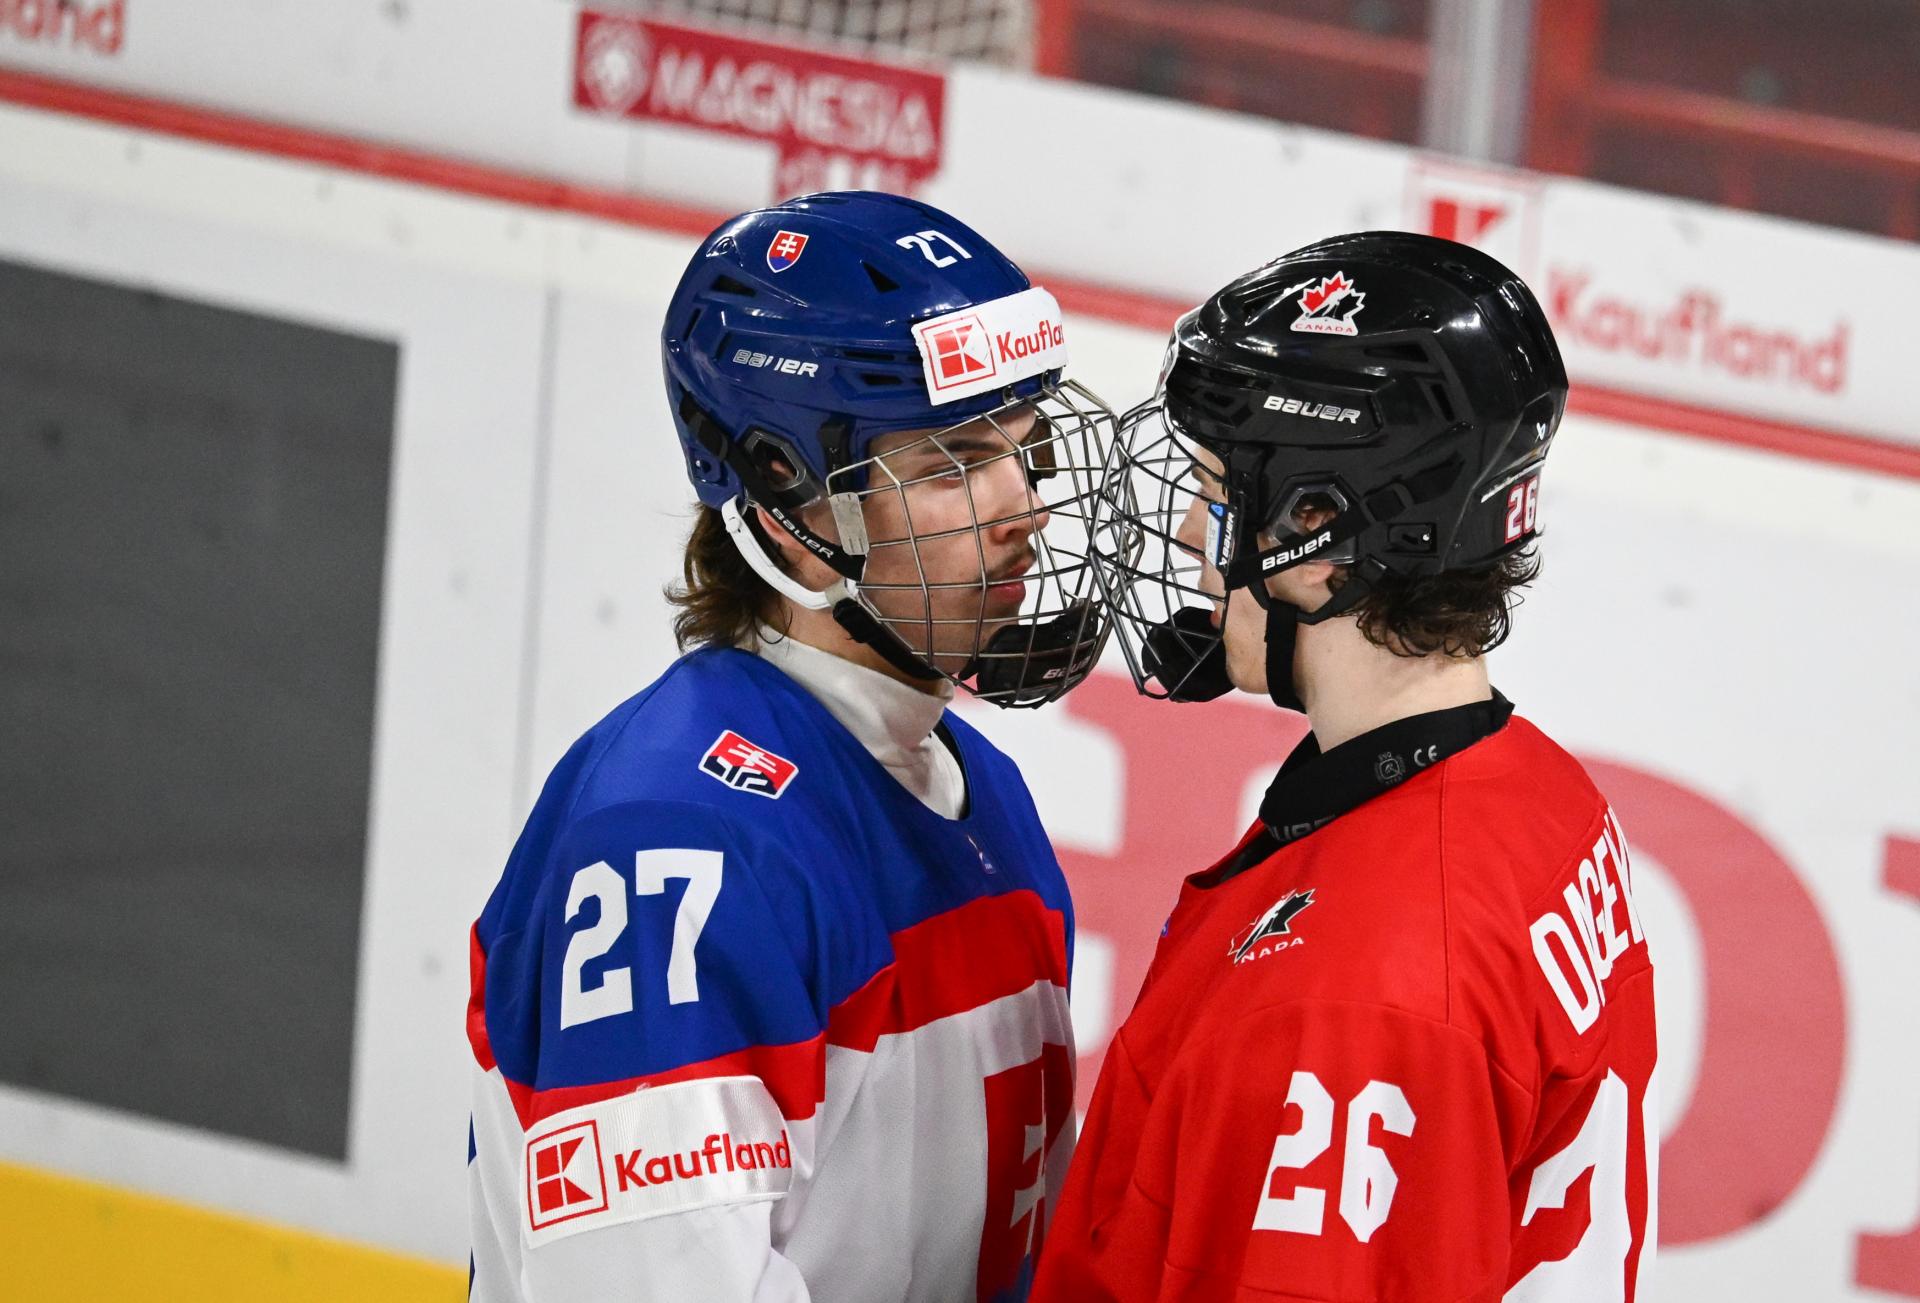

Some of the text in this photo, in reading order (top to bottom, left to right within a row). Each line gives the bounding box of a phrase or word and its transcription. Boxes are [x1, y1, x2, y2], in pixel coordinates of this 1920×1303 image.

[896, 229, 972, 268] 27
[997, 319, 1065, 363] Kaufla
[1295, 323, 1354, 334] CANADA
[1547, 264, 1850, 394] Kaufland
[1263, 395, 1361, 424] BAUER
[772, 507, 834, 559] BAUER
[1506, 475, 1538, 542] 26
[1262, 530, 1332, 571] BAUER
[561, 848, 724, 1031] 27
[615, 1130, 792, 1193] Kaufland
[1252, 1071, 1417, 1244] 26
